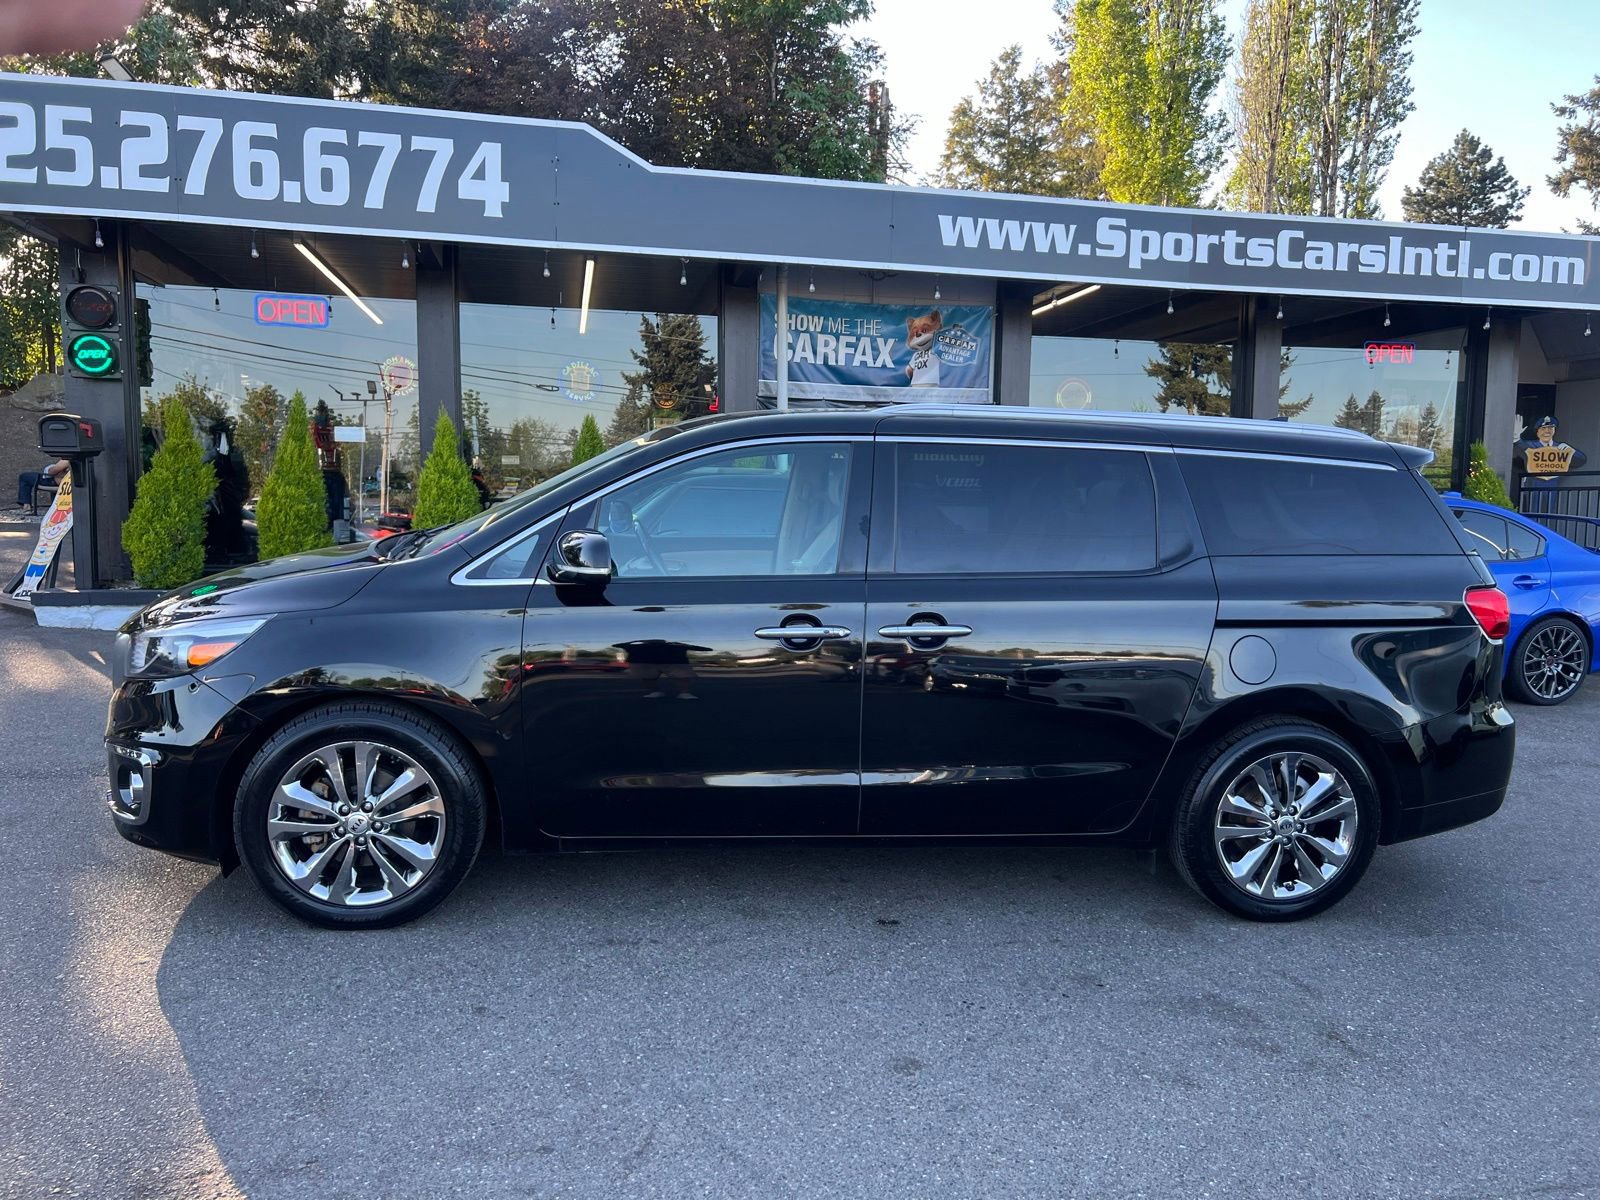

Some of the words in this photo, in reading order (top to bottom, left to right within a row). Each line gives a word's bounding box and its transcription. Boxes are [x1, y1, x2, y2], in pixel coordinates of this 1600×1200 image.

[938, 214, 1585, 286] www.SportsCarsIntl.com
[257, 298, 326, 324] OPEN
[828, 317, 850, 334] ME
[855, 319, 882, 336] THE
[938, 335, 976, 351] CARFAX
[77, 349, 108, 359] OPEN
[914, 350, 930, 360] CAR
[938, 345, 971, 357] ADVANTAGE
[941, 353, 964, 363] DEALER
[1365, 344, 1414, 364] OPEN
[562, 361, 599, 378] CADILLAC
[914, 359, 928, 370] FOX
[1533, 451, 1569, 463] SLOW
[351, 818, 364, 832] KIA
